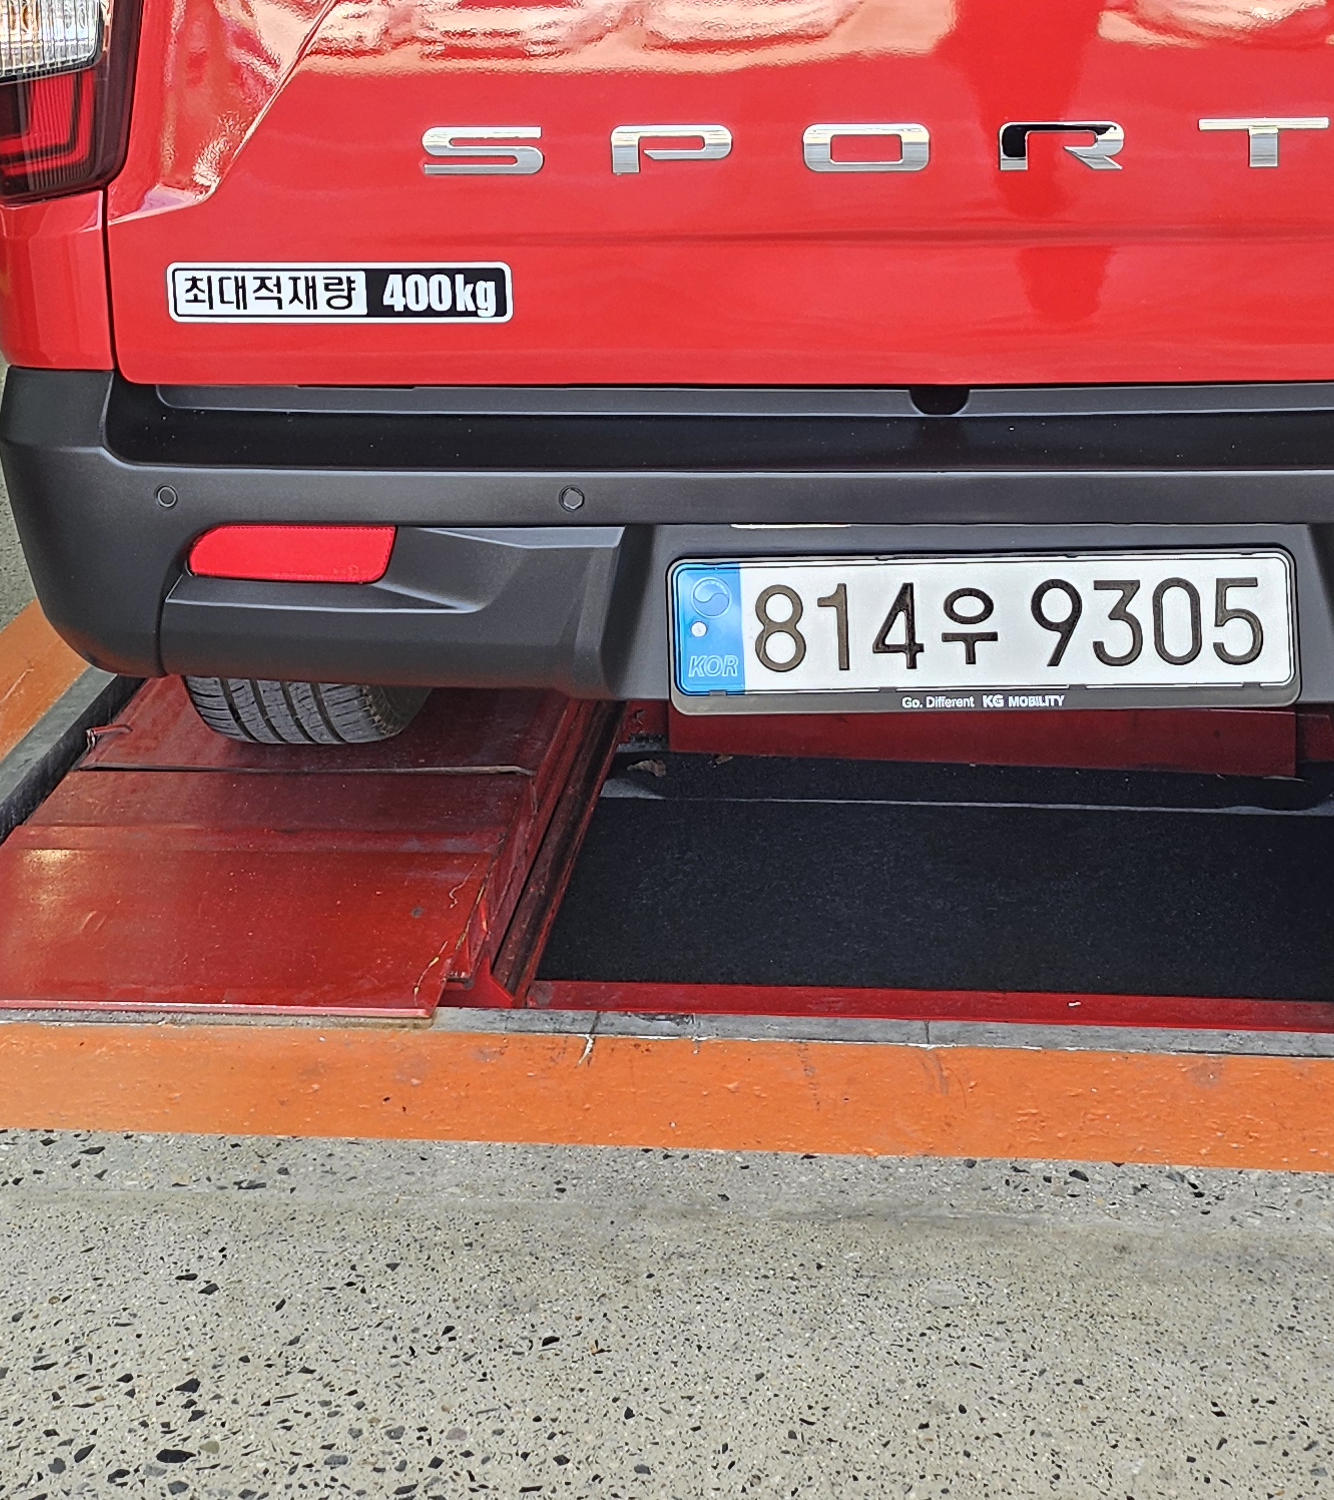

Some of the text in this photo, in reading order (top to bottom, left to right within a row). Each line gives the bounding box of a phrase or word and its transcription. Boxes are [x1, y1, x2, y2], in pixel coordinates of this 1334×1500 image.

[184, 274, 497, 317] 최대적재량 400kg
[755, 576, 1265, 673] 814우 9305
[688, 654, 739, 678] KOR
[901, 694, 1066, 709] Go. Different KG MOBILITY
